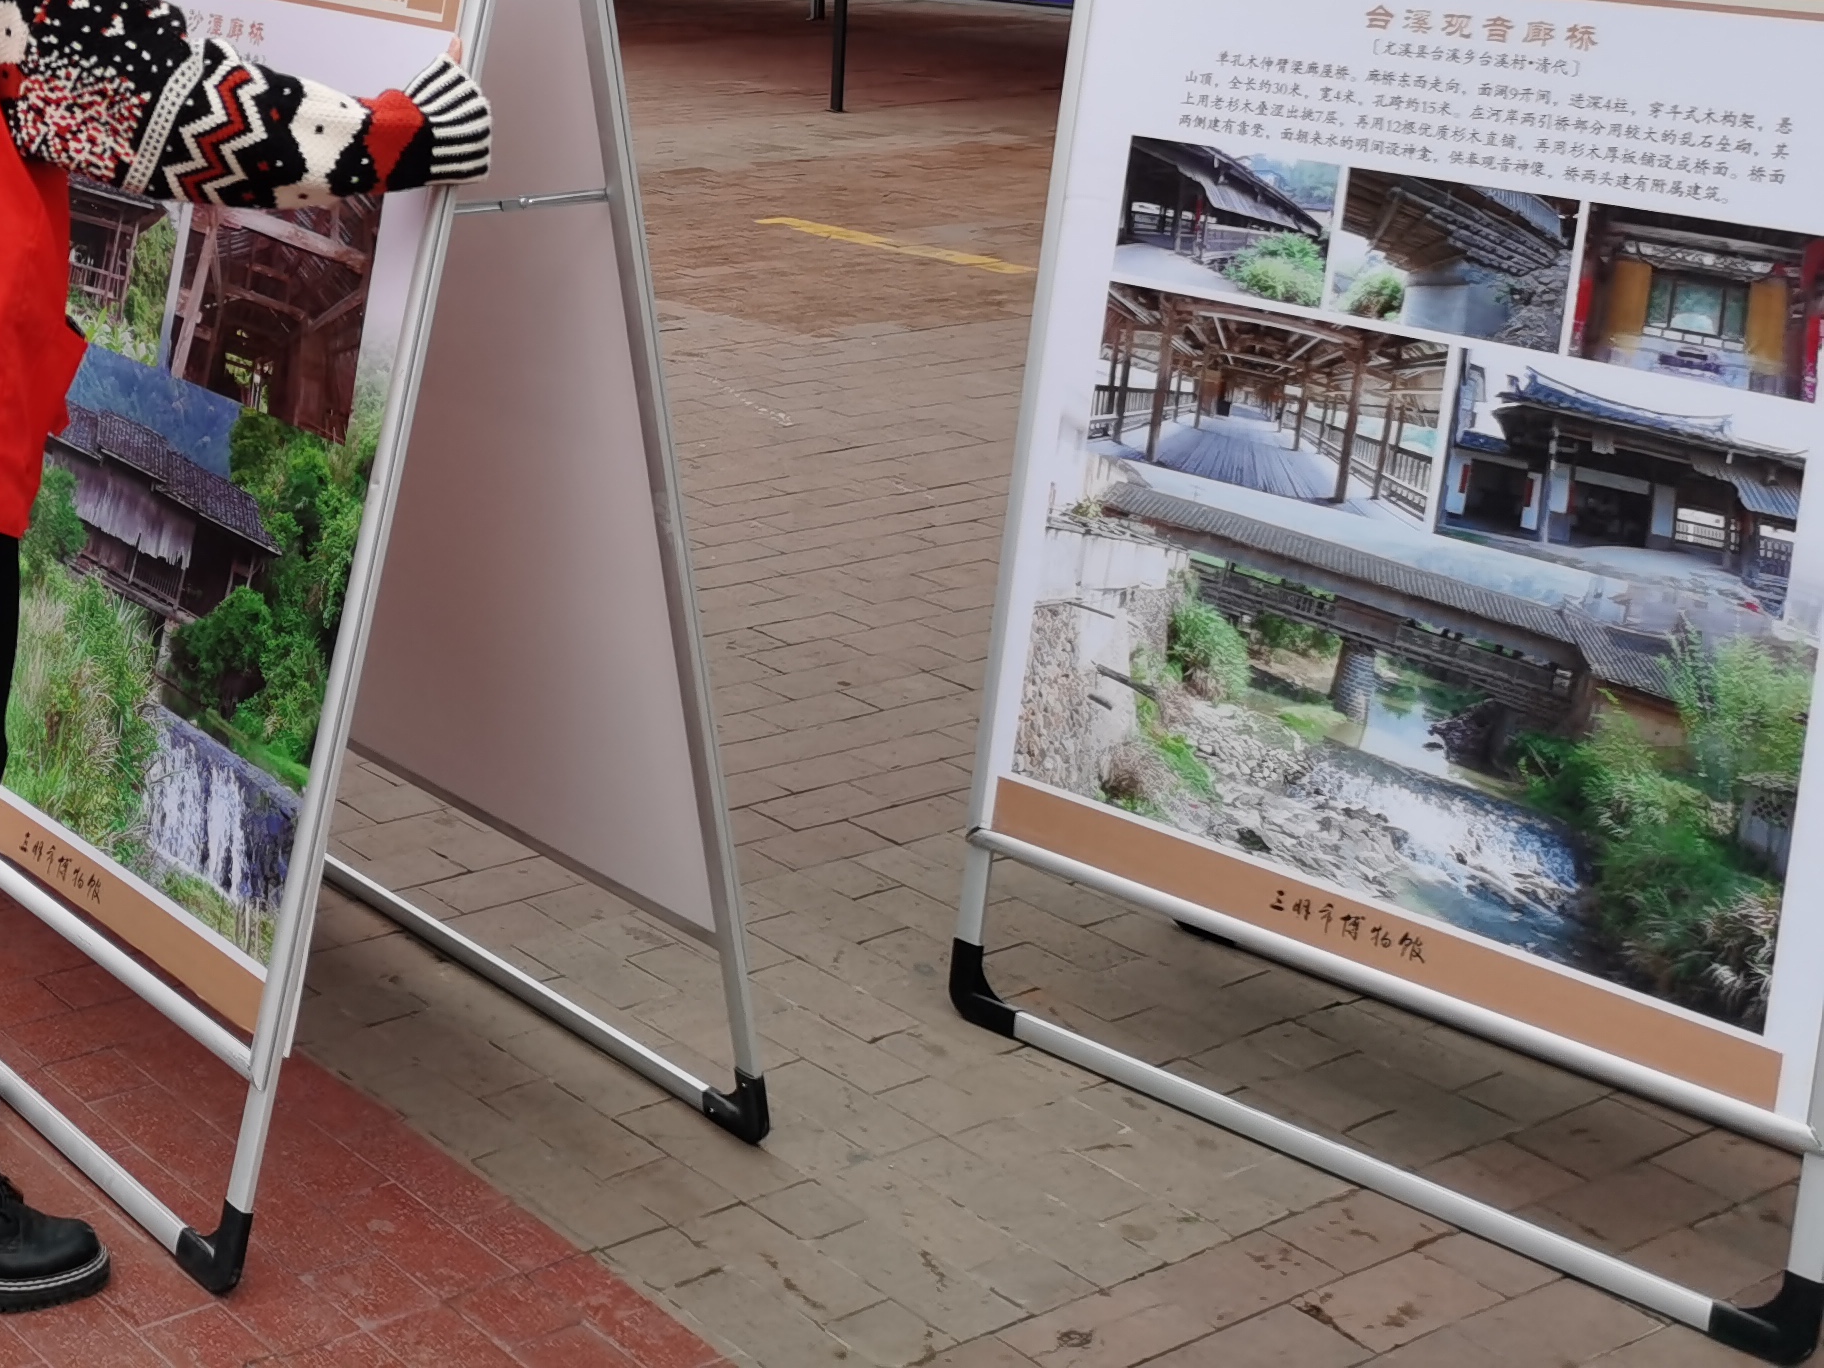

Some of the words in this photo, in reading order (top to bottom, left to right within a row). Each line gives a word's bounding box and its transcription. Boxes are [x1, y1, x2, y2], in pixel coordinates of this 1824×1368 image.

[1365, 4, 1600, 52] 台溪观音廊桥
[18, 831, 102, 905] 三明市博物馆
[1270, 889, 1425, 964] 三明市博物馆
